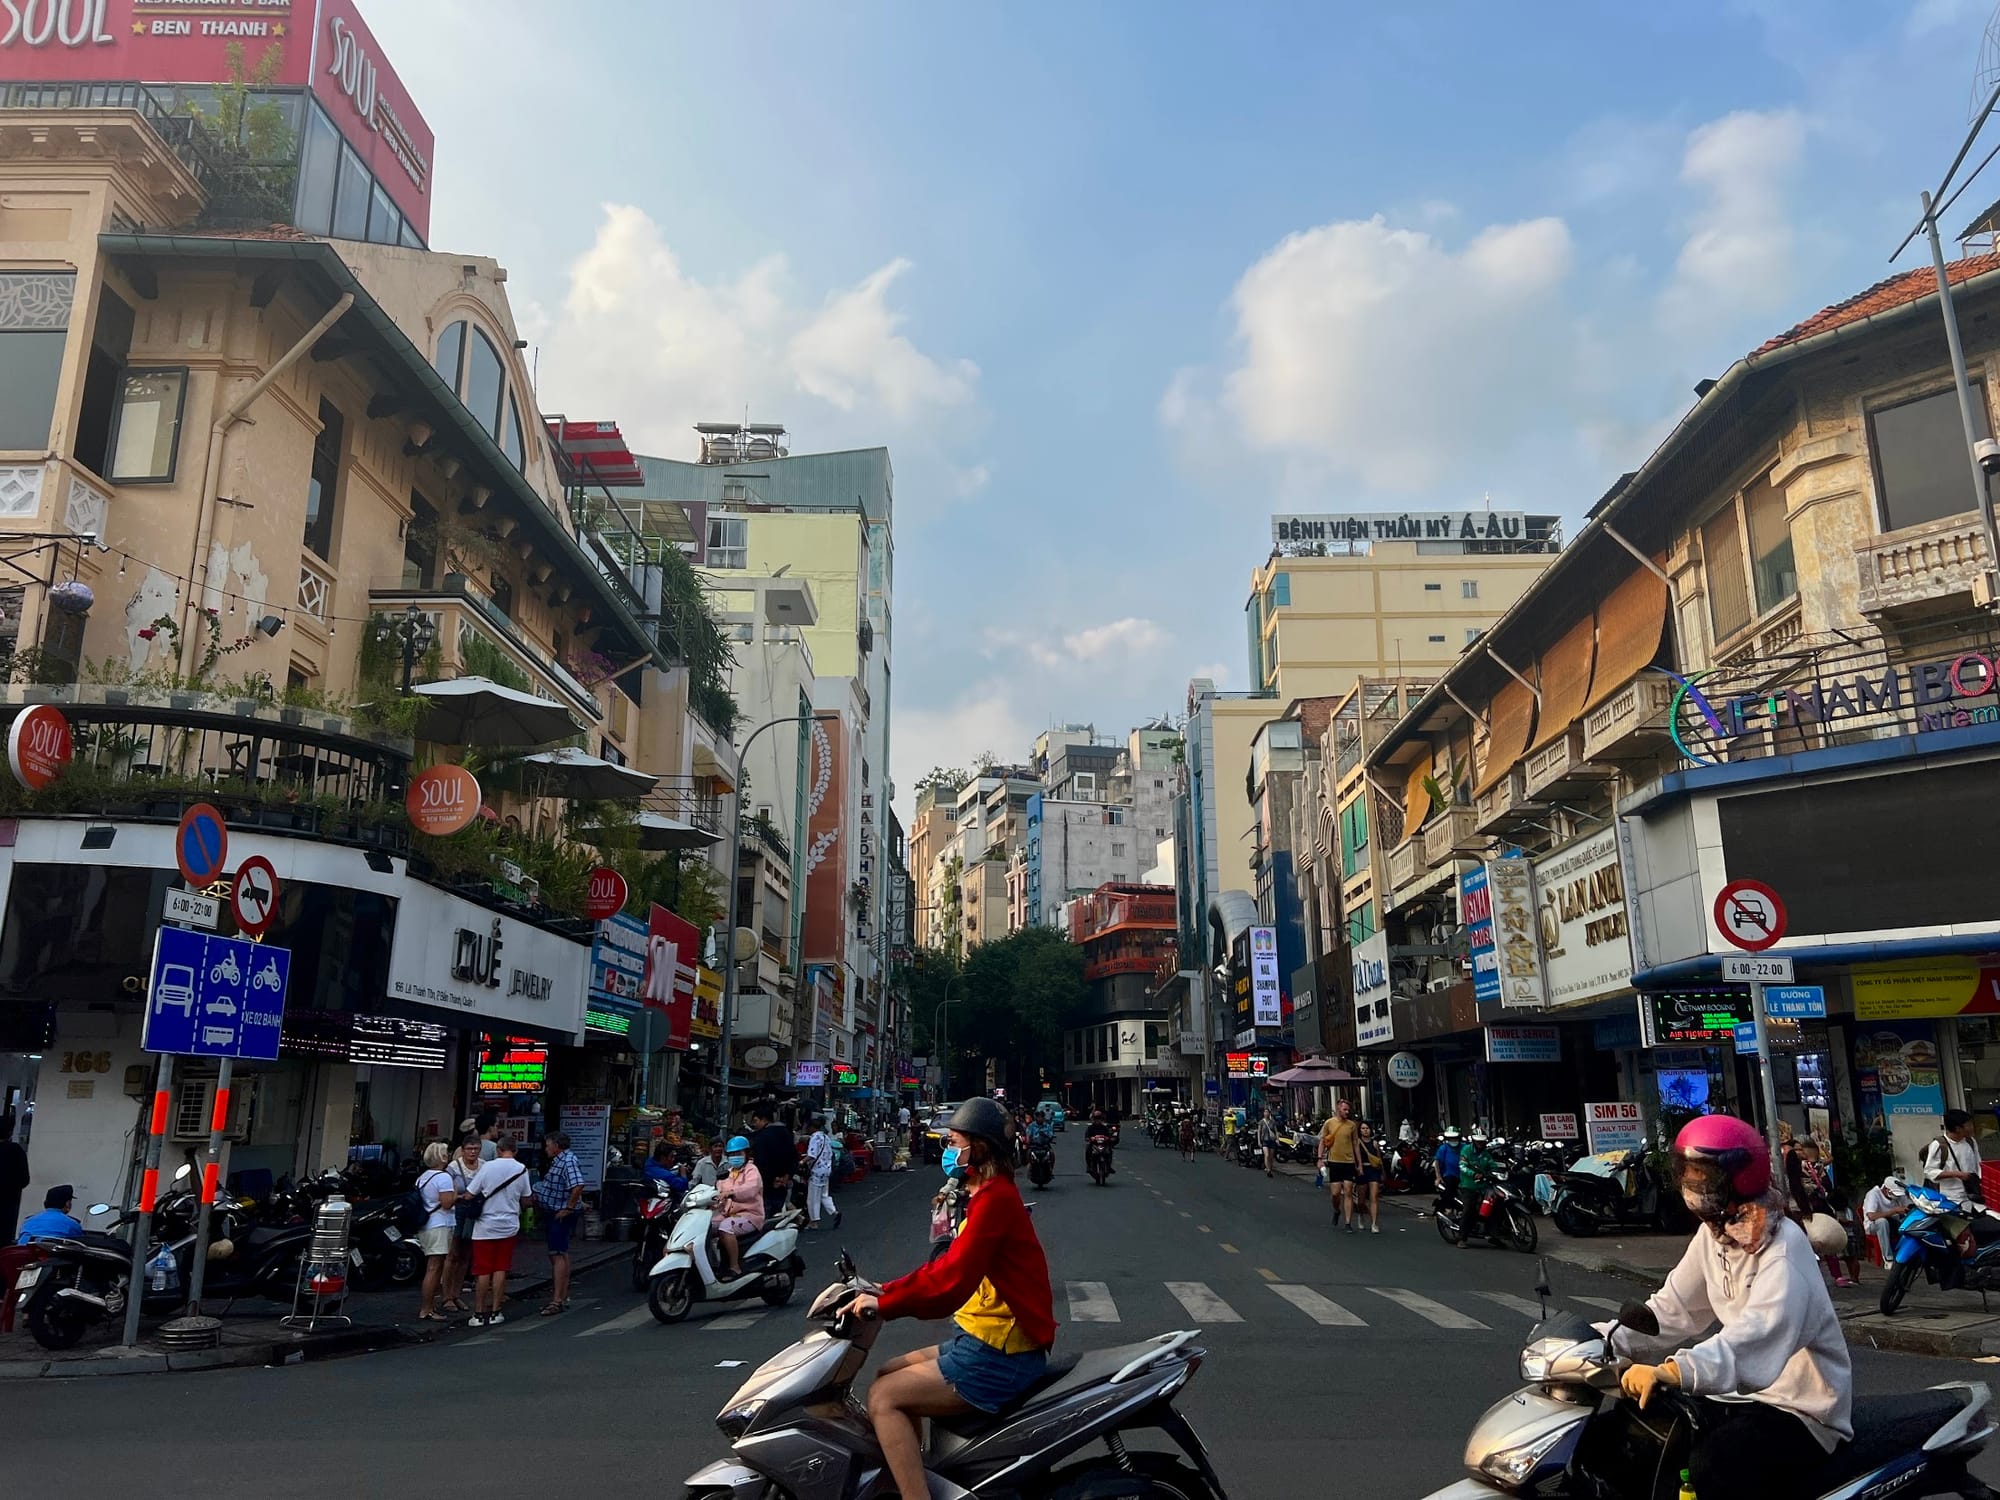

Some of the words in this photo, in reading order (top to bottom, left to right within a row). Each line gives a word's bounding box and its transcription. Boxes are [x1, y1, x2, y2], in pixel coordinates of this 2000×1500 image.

[151, 20, 190, 35] BEN
[200, 21, 268, 36] THANH
[329, 17, 378, 131] SOUL
[383, 127, 398, 154] BEN
[398, 148, 420, 187] THANH
[1279, 517, 1325, 540] BỆNH
[1330, 516, 1369, 541] VIỆN
[1374, 512, 1421, 538] THẨM
[1426, 515, 1451, 537] MỸ
[1914, 652, 2000, 704] BO
[29, 718, 63, 759] SOUL
[420, 777, 465, 807] SOUL
[588, 877, 616, 898] OUL
[1557, 877, 1588, 923] LAN
[1589, 862, 1622, 911] ANH
[507, 968, 552, 1001] JEWELRY
[1256, 979, 1277, 990] SHAMPOO
[244, 1011, 253, 1024] XE
[253, 1013, 261, 1025] 02
[262, 1010, 281, 1027] BÁNH
[1491, 1028, 1520, 1039] TRAVEL
[1522, 1028, 1555, 1039] SERVICE
[1670, 1030, 1684, 1039] AIR
[1686, 1029, 1713, 1038] TICKET
[1543, 1115, 1555, 1123] SIM
[1594, 1104, 1618, 1119] SIM
[1621, 1104, 1637, 1118] 5G
[507, 1119, 525, 1129] CARD
